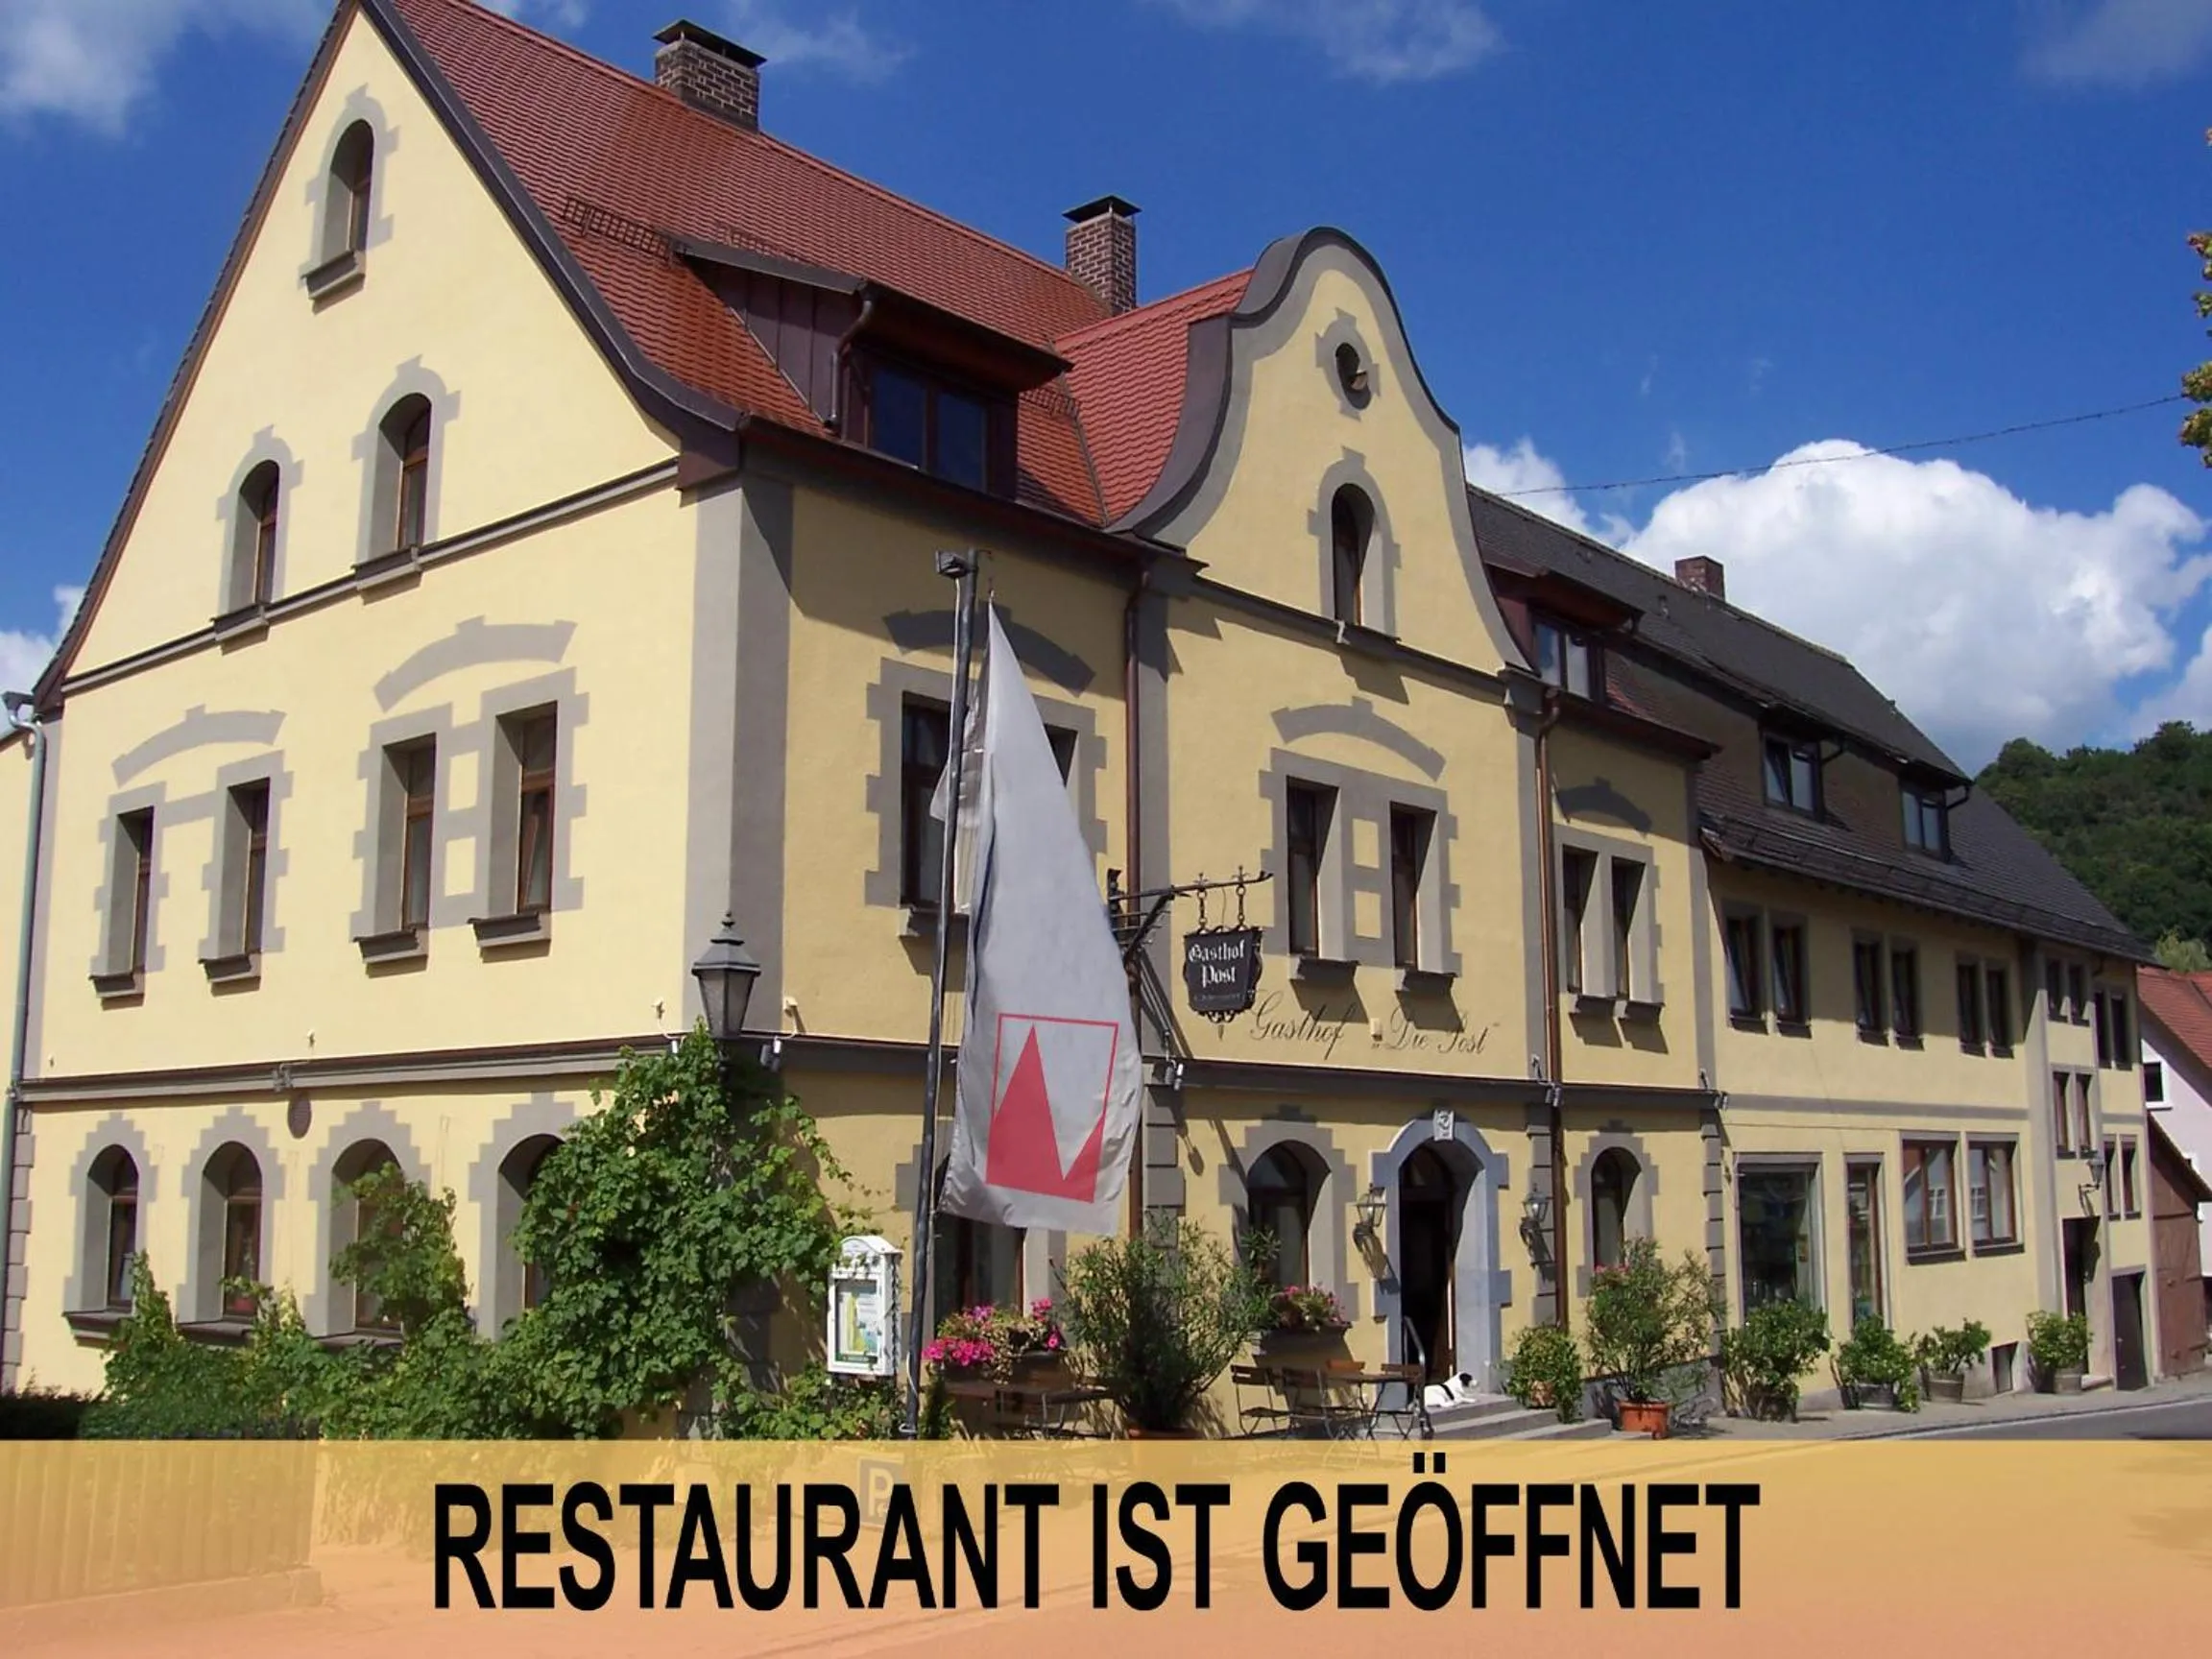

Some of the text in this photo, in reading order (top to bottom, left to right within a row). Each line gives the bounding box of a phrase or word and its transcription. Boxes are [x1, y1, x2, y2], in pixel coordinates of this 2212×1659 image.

[1189, 939, 1245, 962] Gasthof
[1201, 964, 1236, 988] Post
[1250, 989, 1357, 1061] Gasthof
[868, 1468, 895, 1517] P
